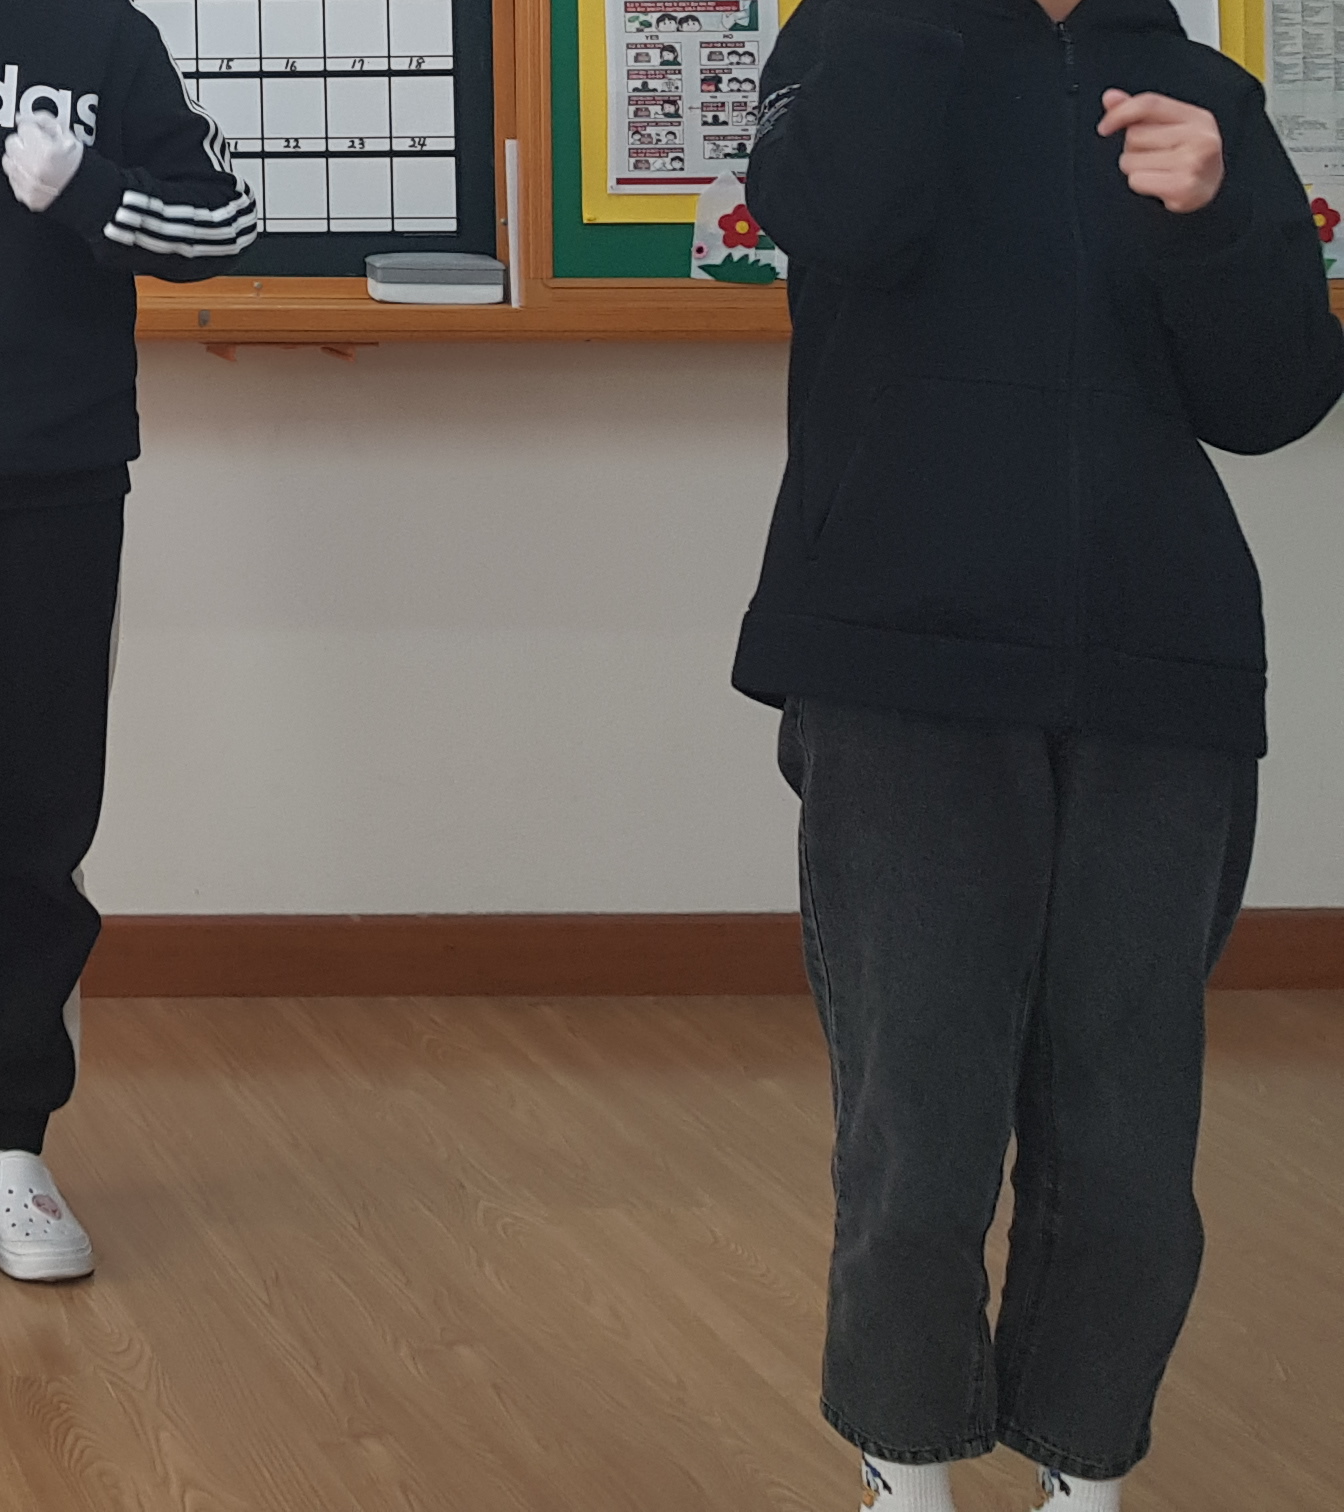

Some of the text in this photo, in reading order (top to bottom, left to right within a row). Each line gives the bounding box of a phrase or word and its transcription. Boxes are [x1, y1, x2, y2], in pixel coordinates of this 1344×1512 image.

[283, 139, 301, 150] 22
[348, 139, 365, 150] 23
[409, 138, 426, 149] 24
